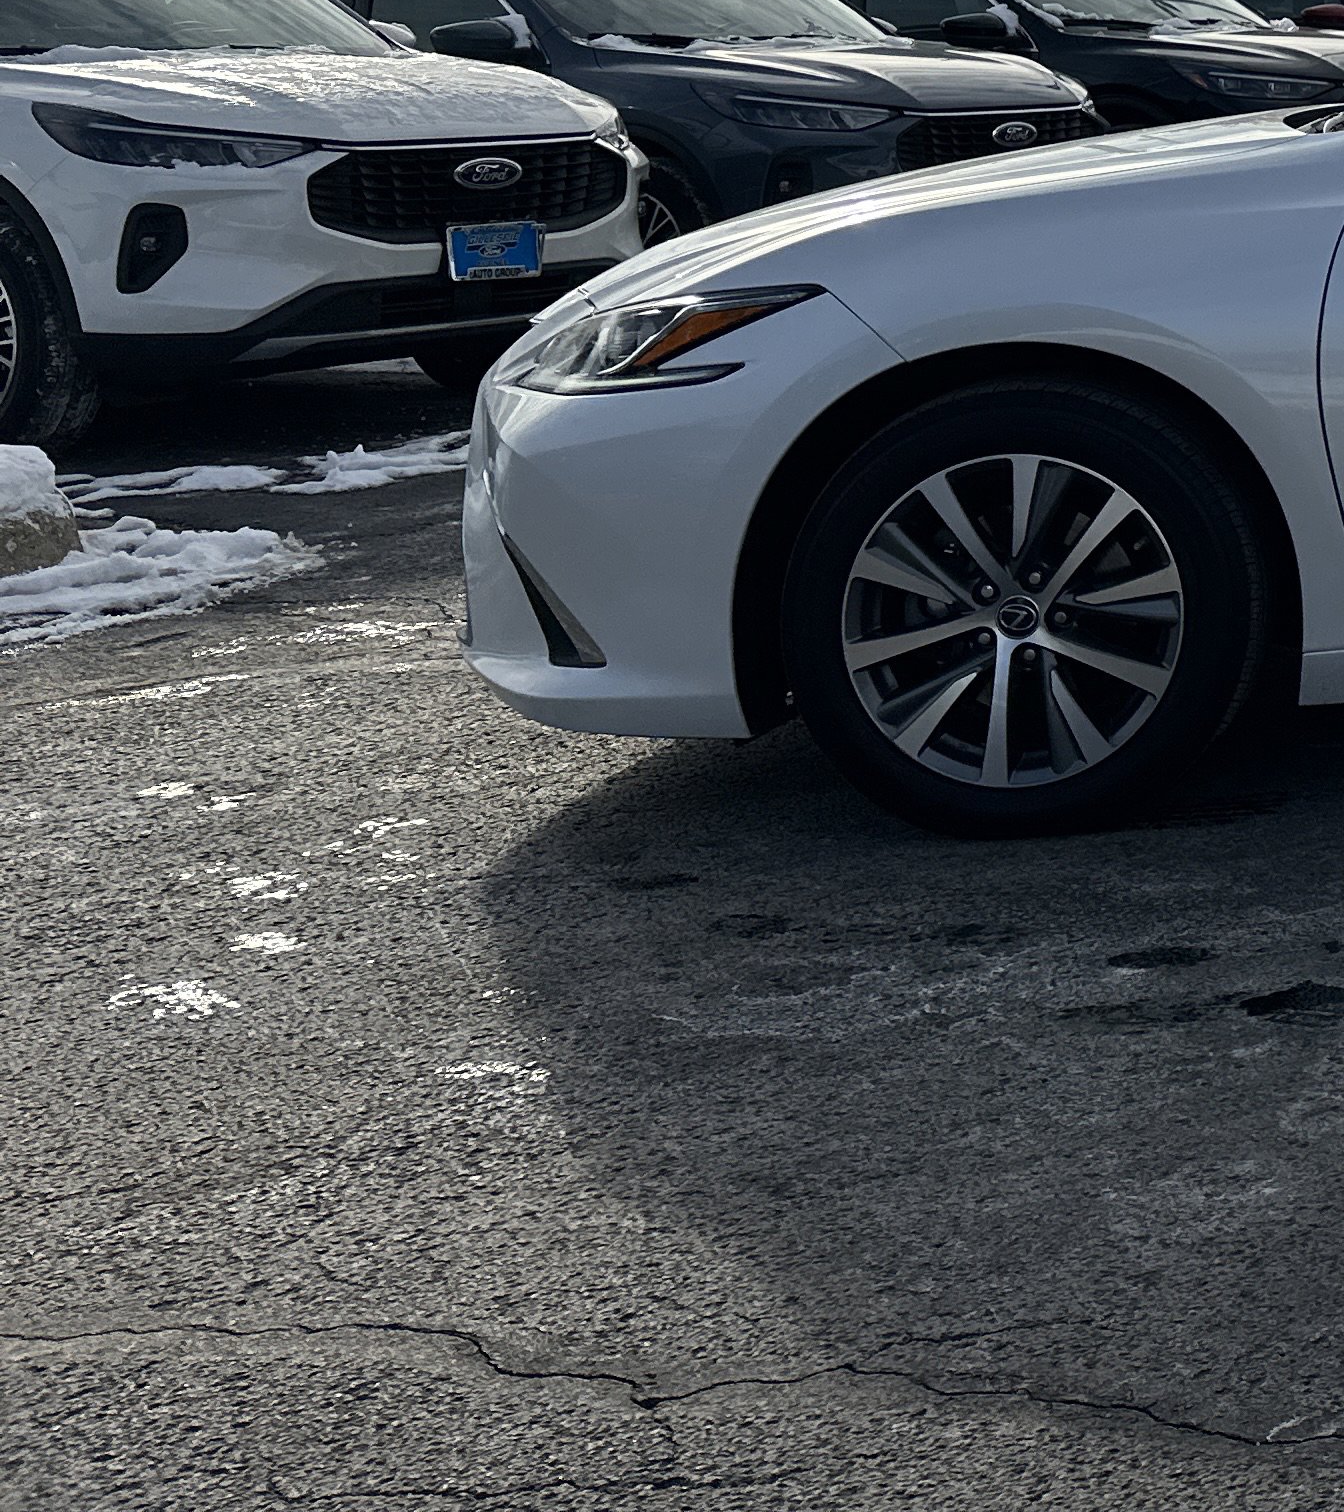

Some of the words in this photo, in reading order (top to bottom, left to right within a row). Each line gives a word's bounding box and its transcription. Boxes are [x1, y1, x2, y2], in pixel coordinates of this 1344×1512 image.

[1004, 127, 1029, 141] Ford
[472, 164, 509, 182] Ford
[473, 268, 493, 279] AUTO
[494, 267, 521, 279] GROUP
